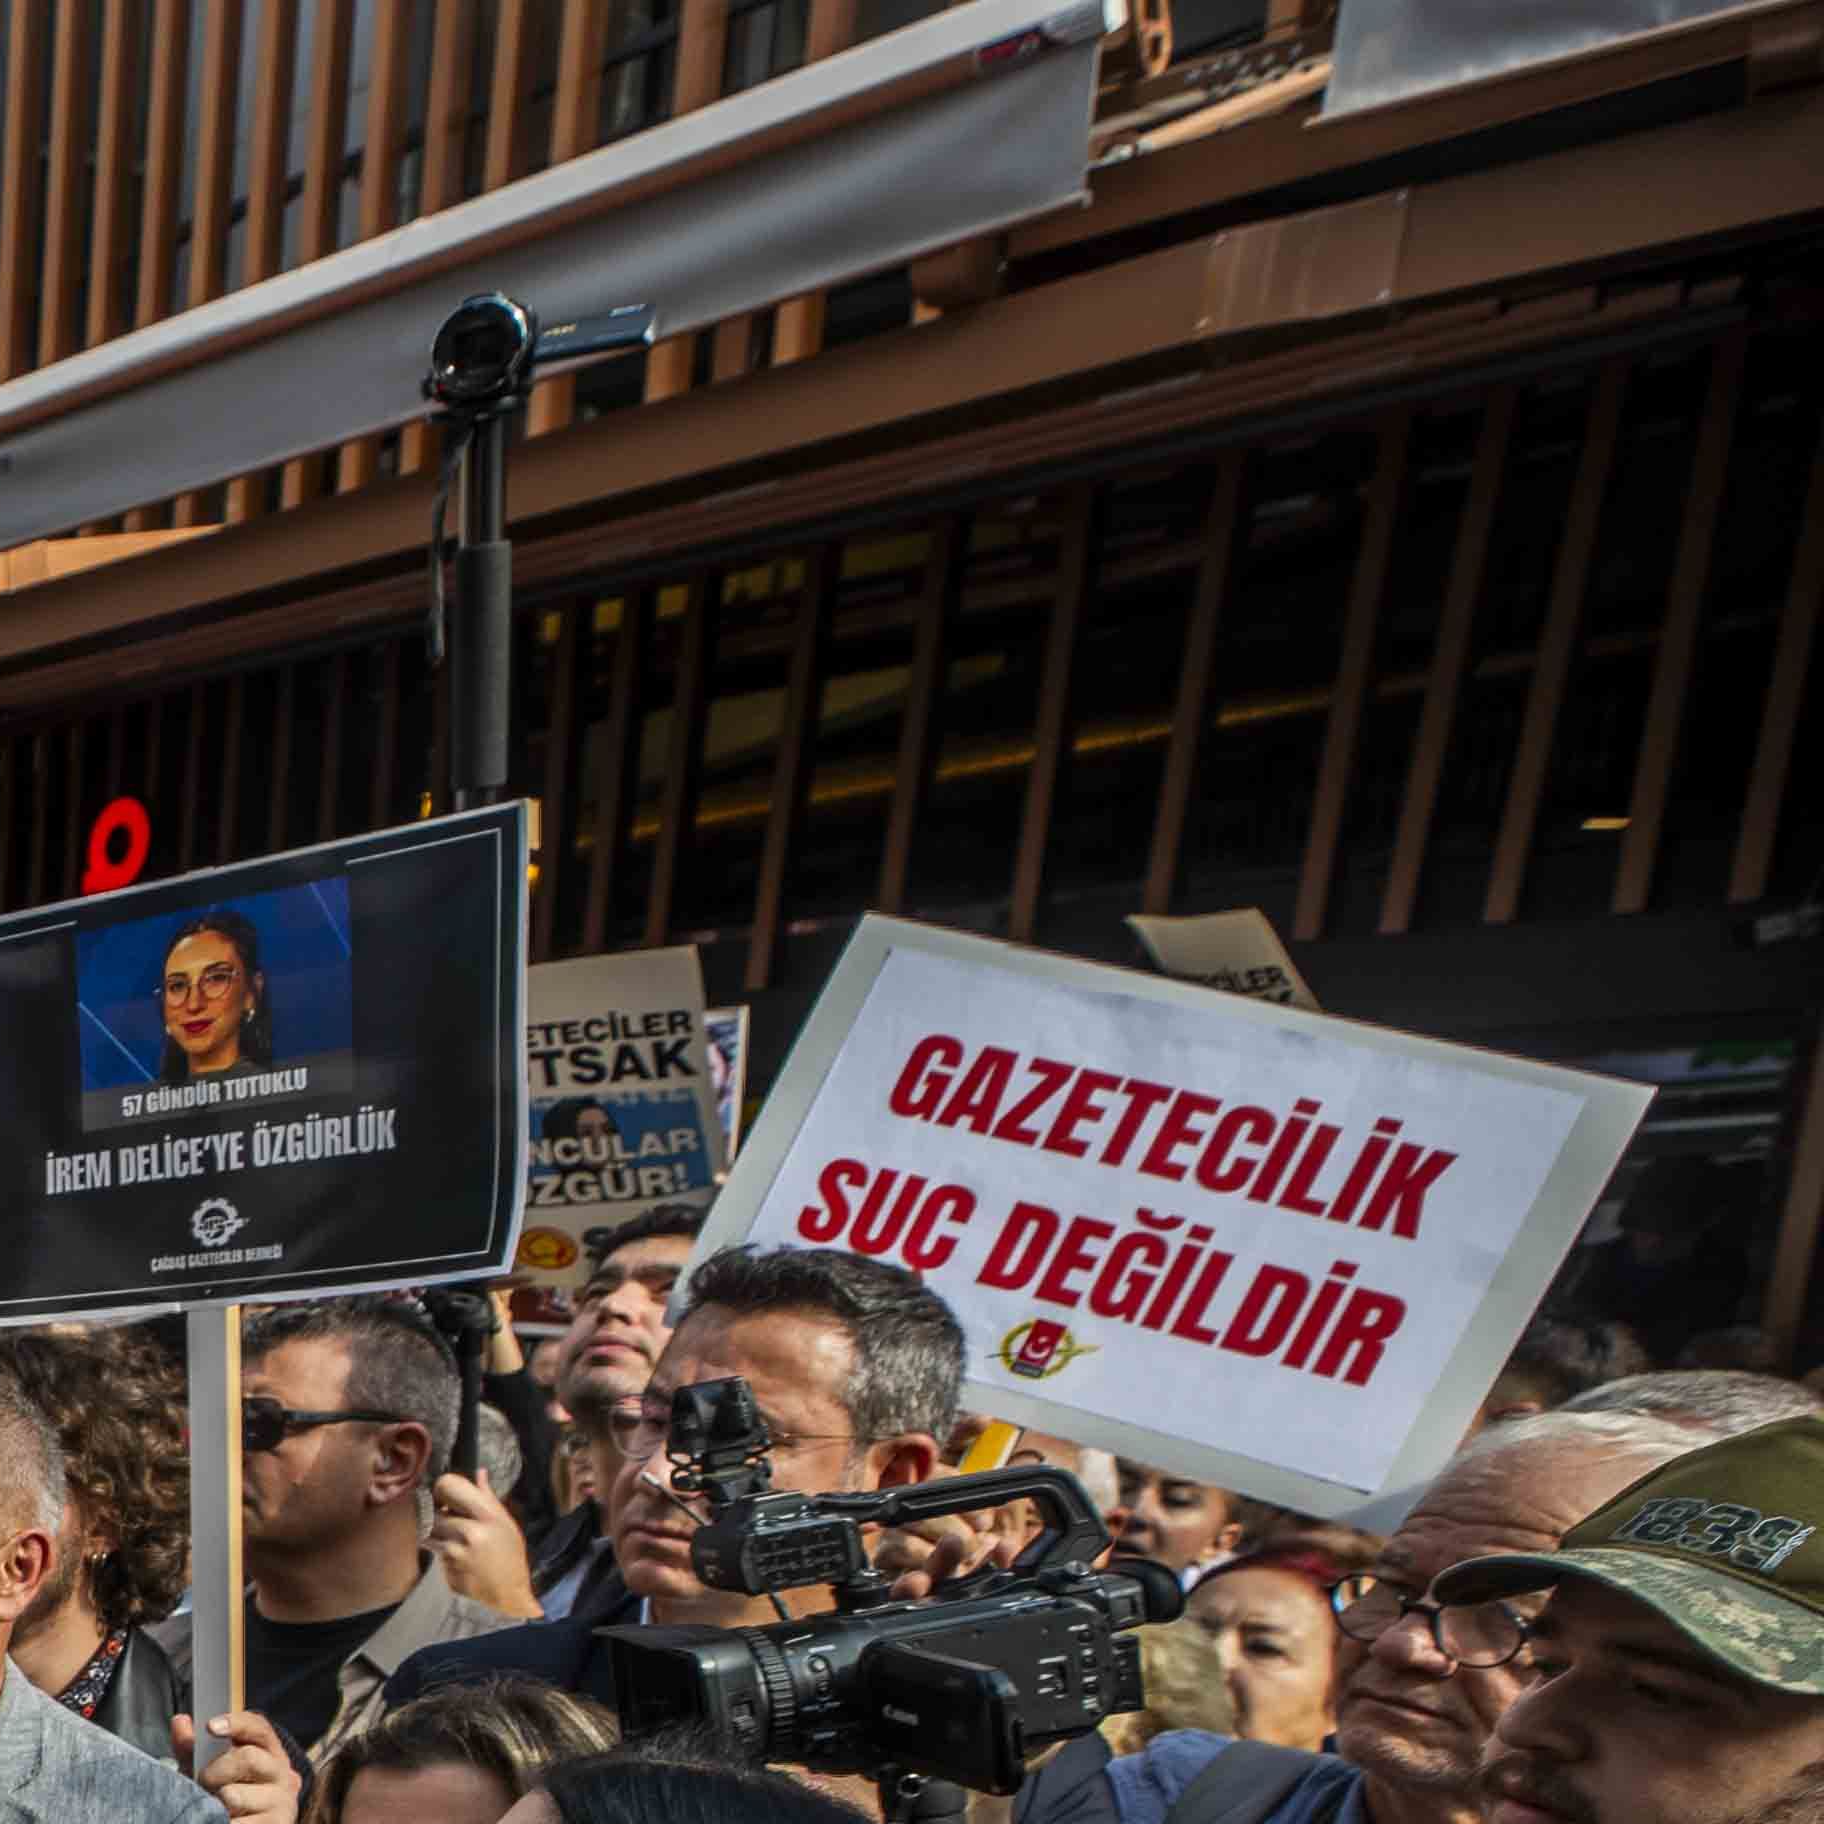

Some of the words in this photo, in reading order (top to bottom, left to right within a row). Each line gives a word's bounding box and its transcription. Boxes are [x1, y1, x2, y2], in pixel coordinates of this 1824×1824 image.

[528, 1037, 699, 1087] TSAK
[121, 1093, 144, 1117] 57
[146, 1079, 221, 1115] GÜNDÜR
[225, 1066, 307, 1102] TUTUKLU
[45, 1148, 111, 1196] İREM
[118, 1125, 244, 1187] DELİCE'YE
[252, 1107, 395, 1166] ÖZGÜRLÜK
[529, 1126, 699, 1171] NCULAR
[889, 1033, 1460, 1242] GAZETECİLİK
[527, 1158, 691, 1206] ZGÜR!
[797, 1158, 978, 1272] SUÇ
[975, 1203, 1409, 1386] DEĞİLDİR
